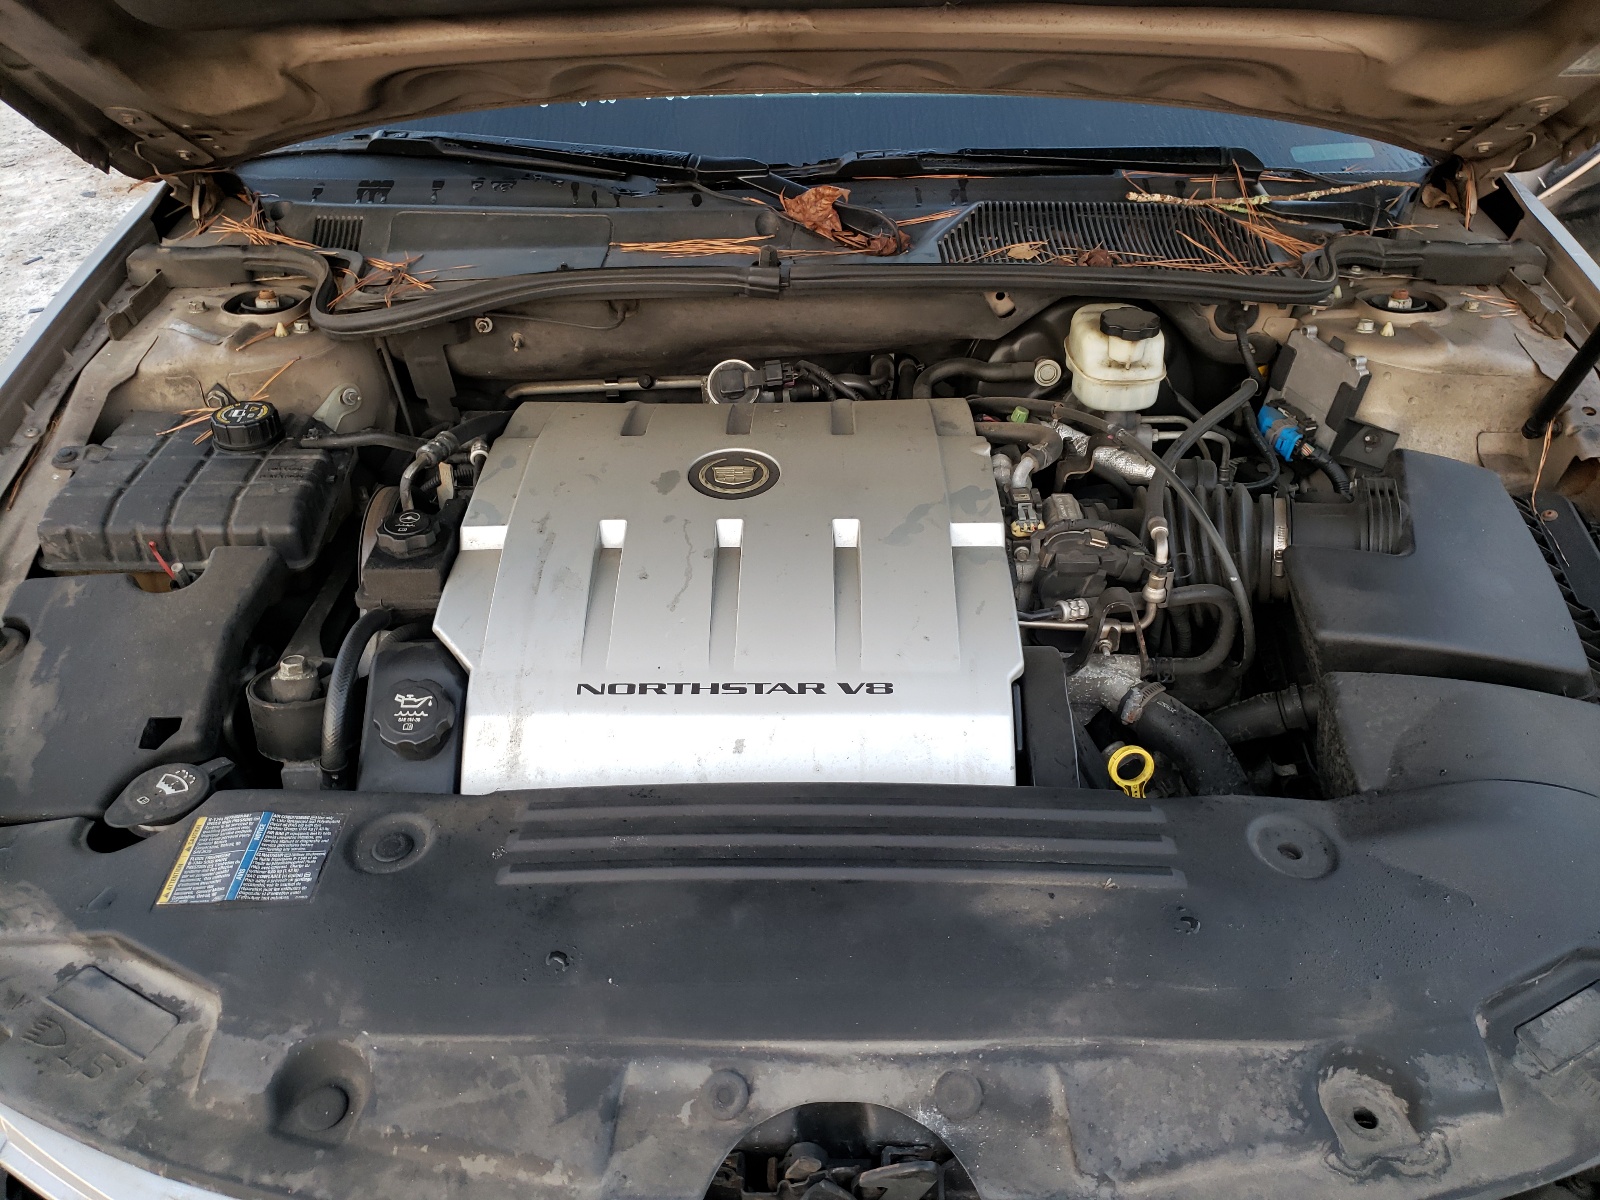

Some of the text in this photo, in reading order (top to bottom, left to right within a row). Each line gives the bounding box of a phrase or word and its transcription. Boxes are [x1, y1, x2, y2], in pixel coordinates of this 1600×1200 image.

[576, 682, 894, 695] NORTHSTAR V8
[166, 863, 184, 891] ATTENTION
